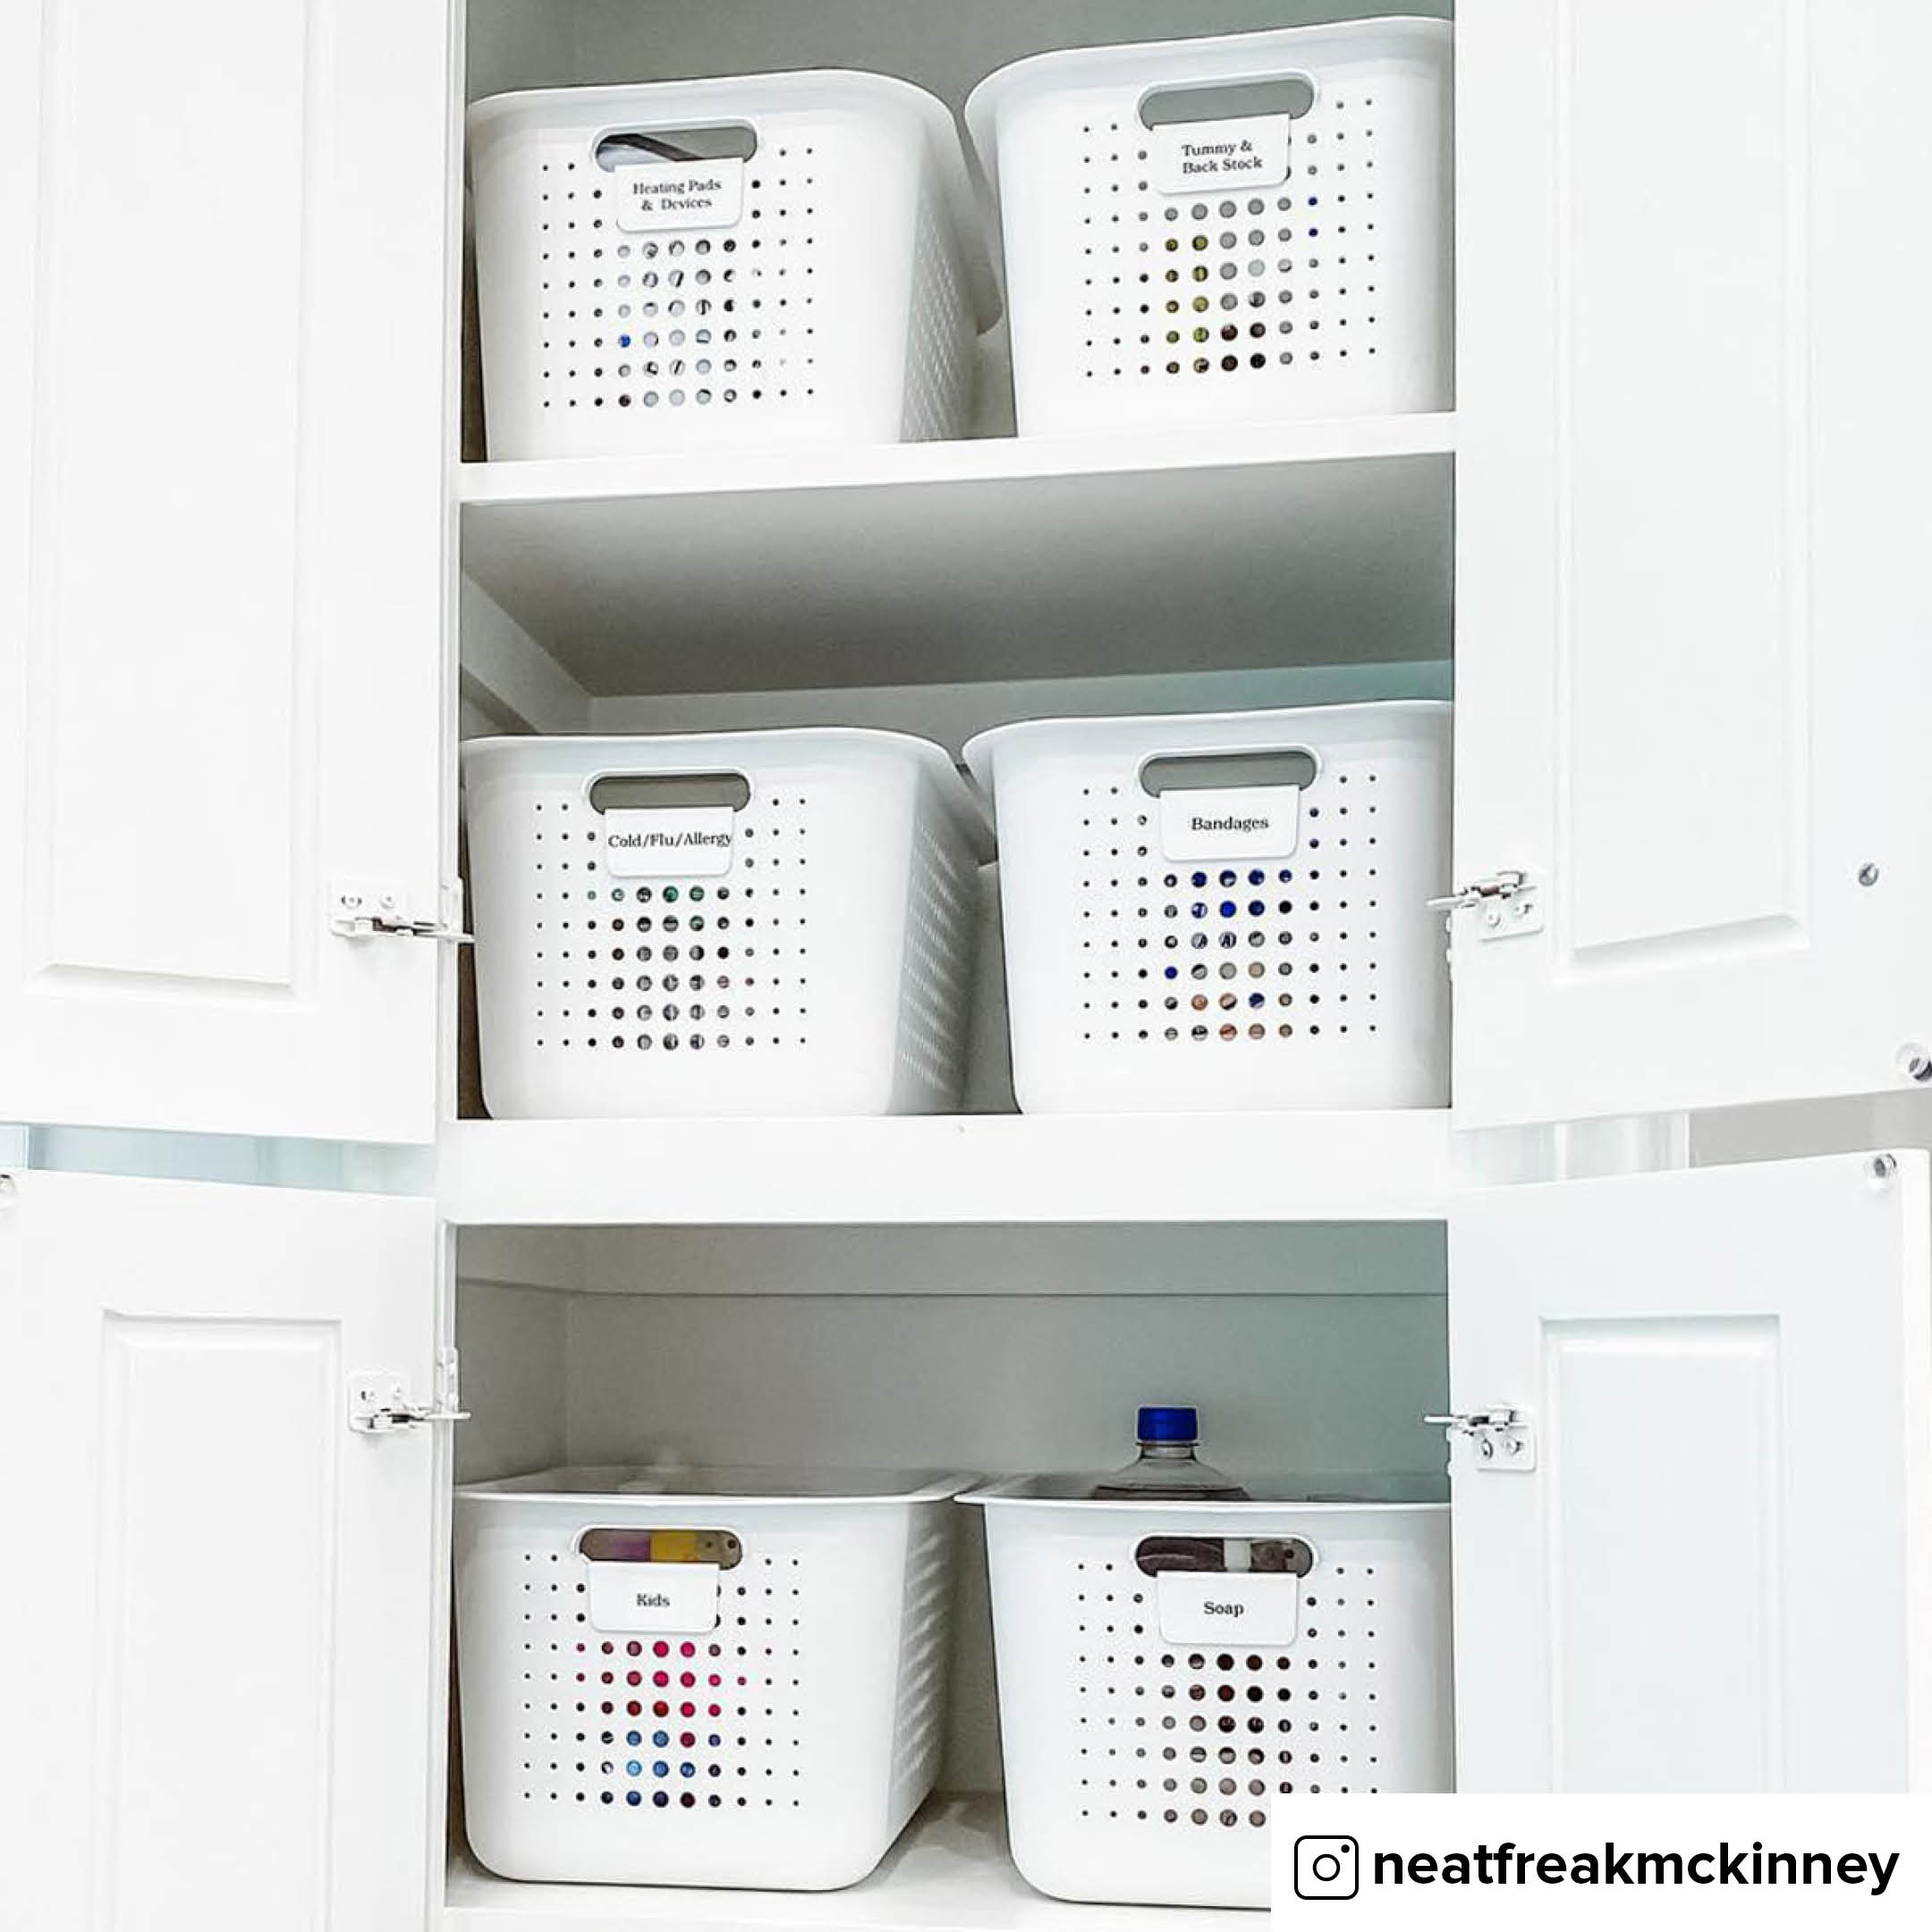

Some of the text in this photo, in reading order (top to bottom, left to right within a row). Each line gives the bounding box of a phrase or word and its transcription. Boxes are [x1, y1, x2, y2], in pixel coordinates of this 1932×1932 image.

[1182, 140, 1252, 158] Tummy &
[1182, 156, 1263, 174] Back Stock
[632, 179, 722, 196] Heating Pads
[642, 197, 712, 210] & Devices
[1191, 816, 1269, 834] Bandages
[607, 831, 732, 849] Cold/Flu/Allergy
[636, 1593, 670, 1608] Kids
[1204, 1601, 1244, 1617] Soap
